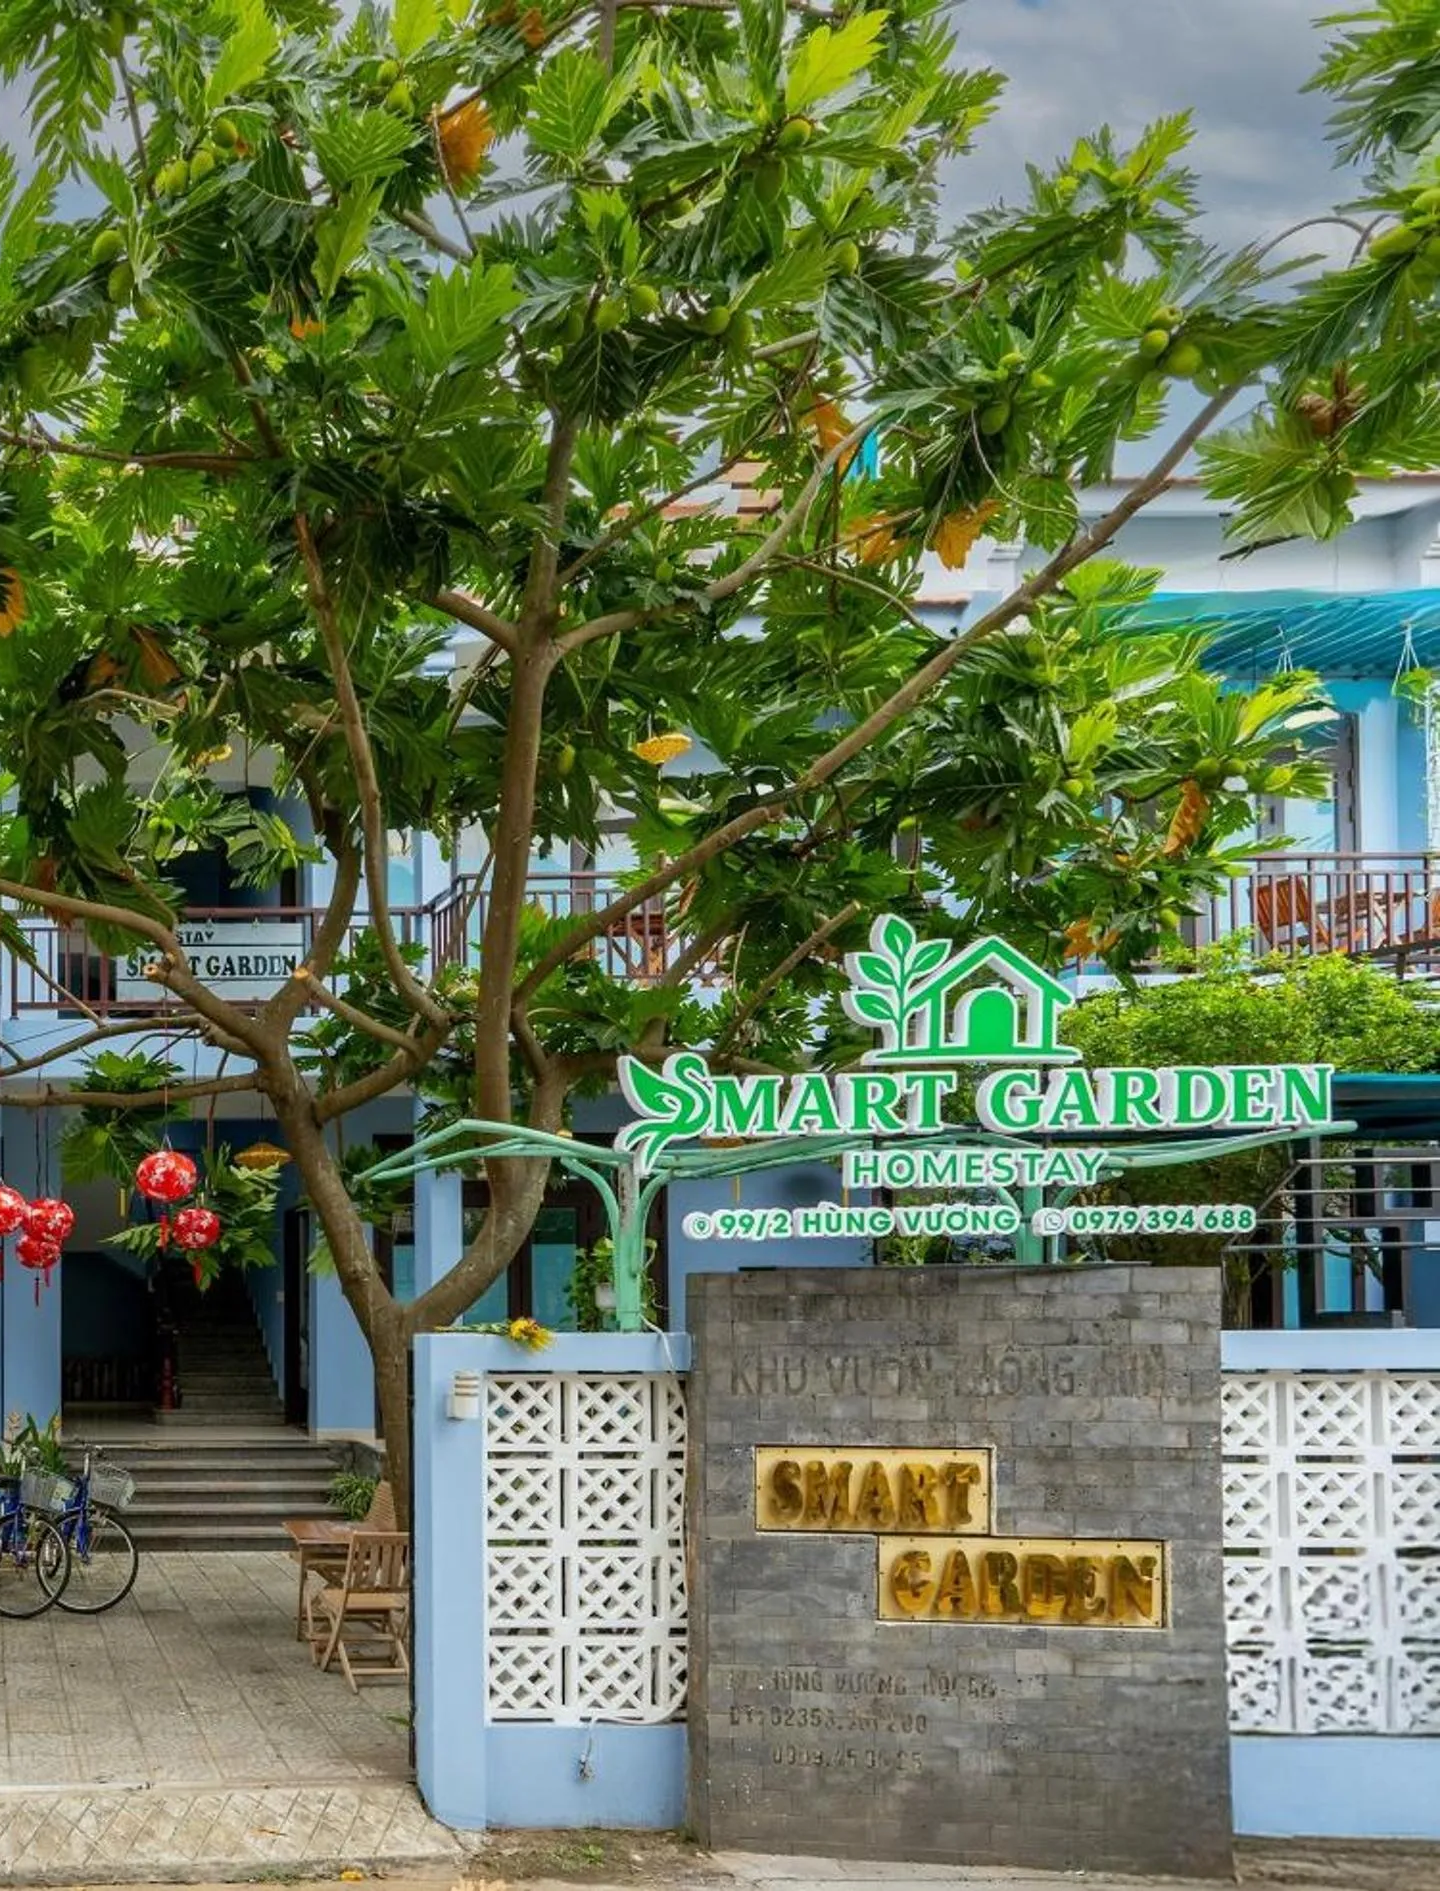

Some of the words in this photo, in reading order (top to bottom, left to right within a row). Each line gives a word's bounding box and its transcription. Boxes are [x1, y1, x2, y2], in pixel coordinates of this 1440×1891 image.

[205, 955, 296, 976] GARDEN
[622, 1053, 955, 1172] SMART
[988, 1066, 1332, 1129] GARDEN
[852, 1151, 1104, 1186] HOMESTAY
[718, 1212, 791, 1238] 99/2
[802, 1205, 892, 1235] HÙNG
[1071, 1210, 1139, 1231] 0979
[1146, 1210, 1196, 1231] 394
[1203, 1209, 1254, 1231] 688
[769, 1459, 982, 1528] SMART
[890, 1549, 1158, 1621] GARDEN
